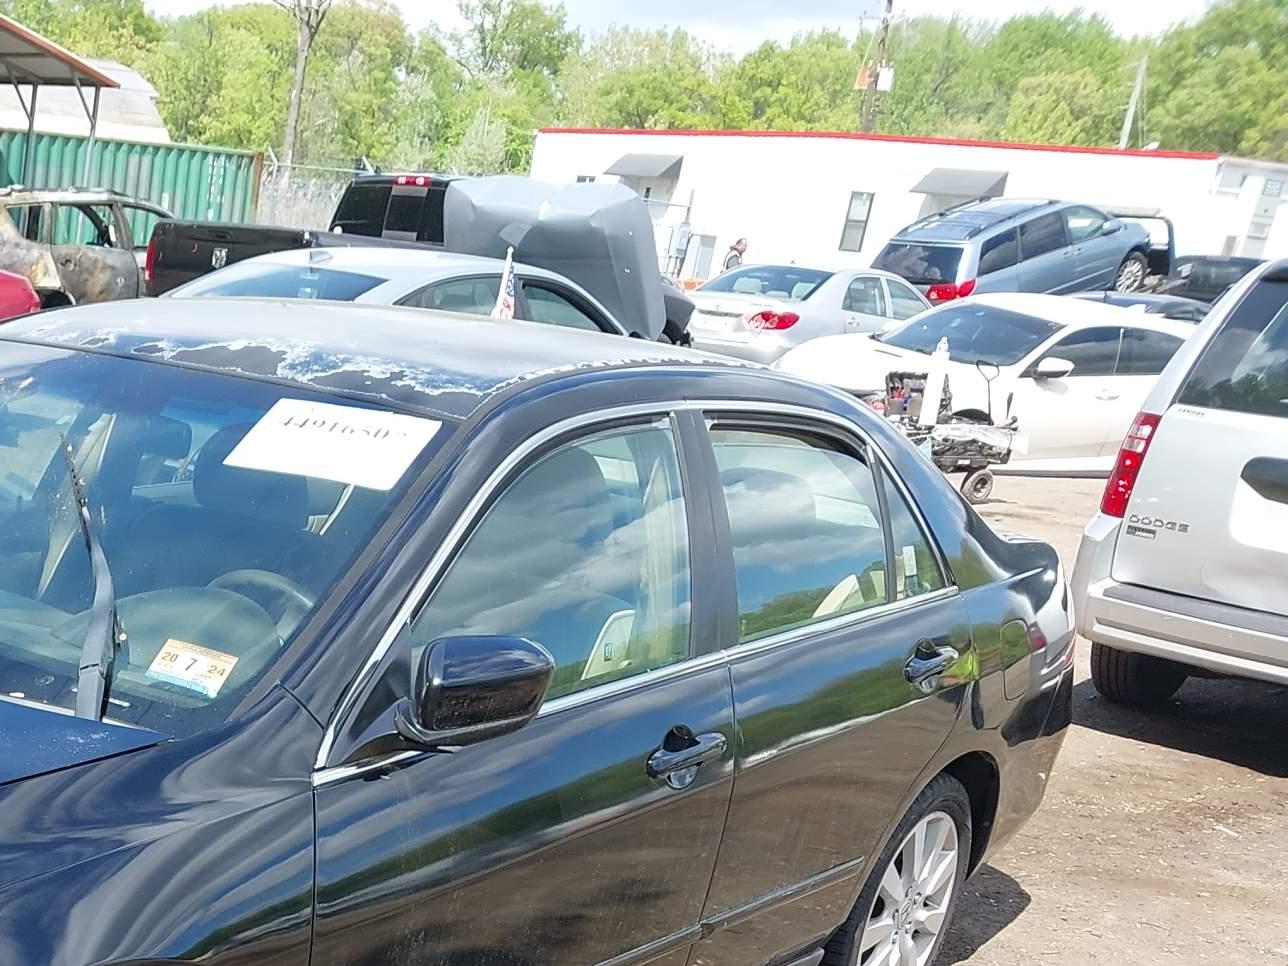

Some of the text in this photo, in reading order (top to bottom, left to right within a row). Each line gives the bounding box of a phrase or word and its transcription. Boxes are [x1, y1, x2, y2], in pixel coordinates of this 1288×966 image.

[1129, 514, 1190, 533] DODGE
[161, 651, 227, 676] 20 7 24
